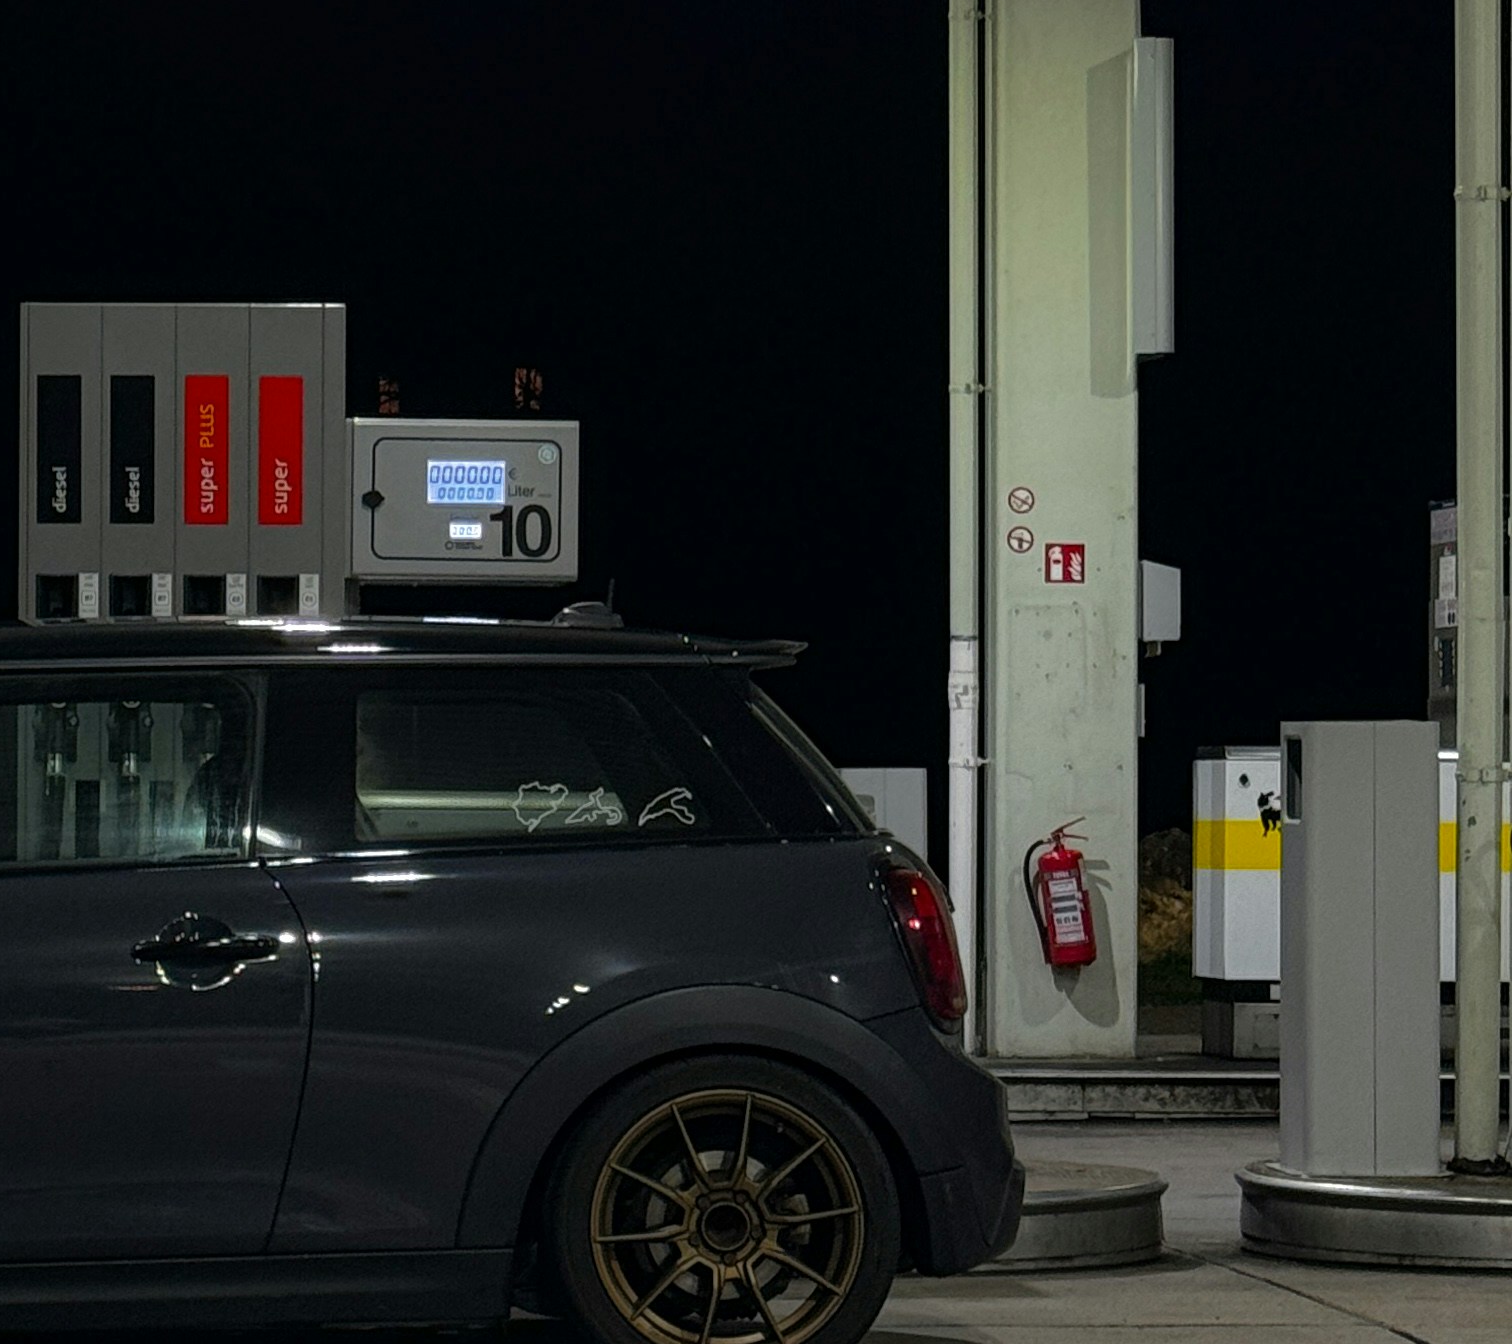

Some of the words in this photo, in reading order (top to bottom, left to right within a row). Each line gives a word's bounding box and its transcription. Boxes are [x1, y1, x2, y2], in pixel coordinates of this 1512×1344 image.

[200, 404, 214, 448] PLUS
[52, 466, 67, 513] diesel
[125, 466, 140, 513] diesel
[200, 458, 218, 514] super
[274, 458, 292, 514] super
[508, 485, 535, 497] Liter
[489, 504, 552, 557] 10
